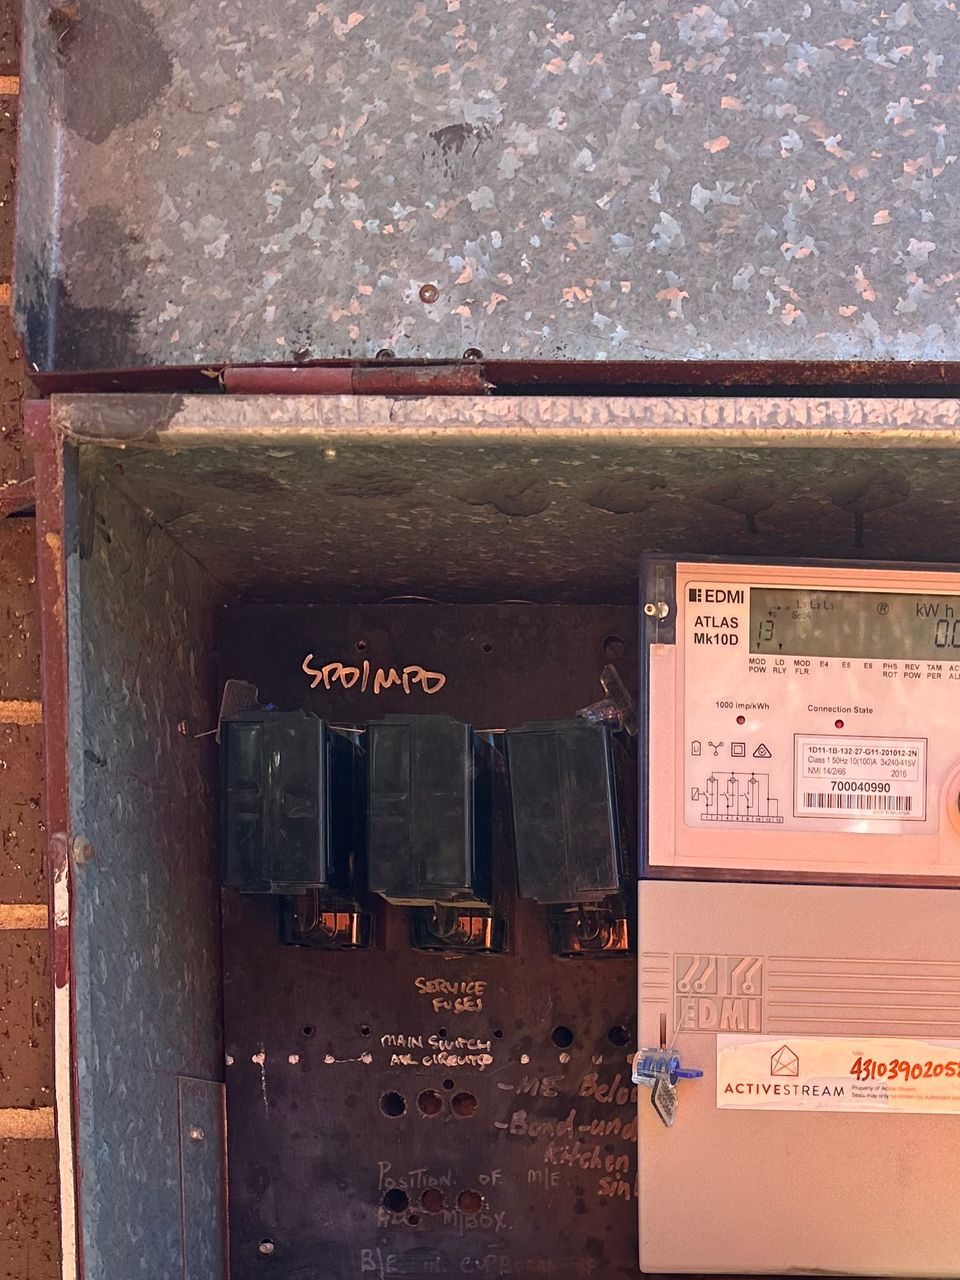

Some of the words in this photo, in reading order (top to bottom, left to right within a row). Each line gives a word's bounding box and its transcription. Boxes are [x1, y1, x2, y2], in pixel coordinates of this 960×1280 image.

[705, 589, 744, 604] EDMI
[694, 616, 739, 628] ATLAS
[694, 633, 739, 646] Mk10D
[716, 702, 734, 710] 1000
[808, 704, 851, 714] Connection
[854, 706, 874, 714] State
[808, 756, 825, 764] Class
[830, 780, 891, 793] 700040990
[414, 976, 488, 996] SERVICE
[432, 996, 483, 1014] FUSES
[680, 997, 756, 1030] EDMI
[380, 1034, 424, 1049] MAIN
[724, 1083, 845, 1097] ACTIVESTREAM
